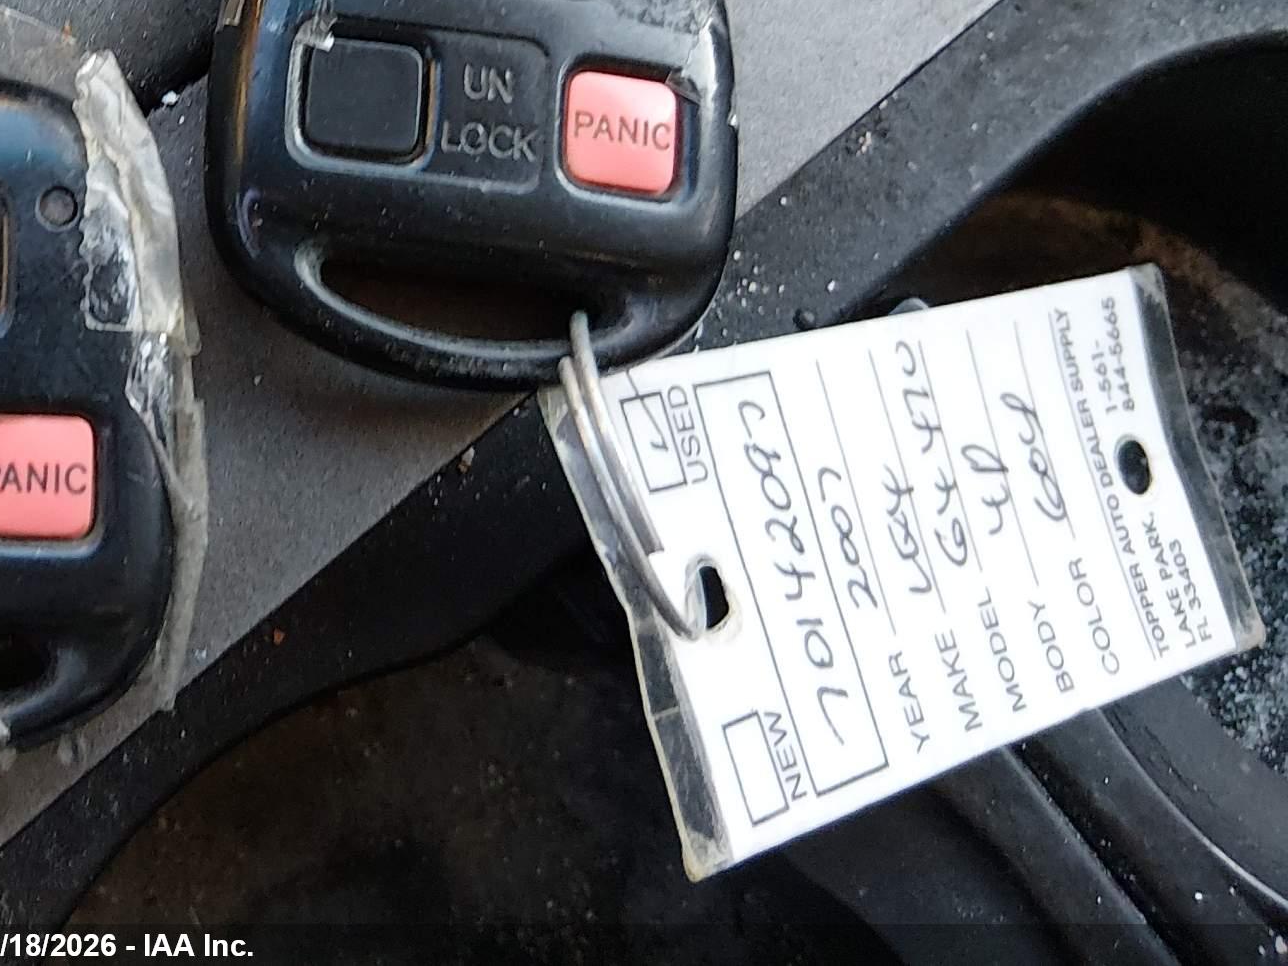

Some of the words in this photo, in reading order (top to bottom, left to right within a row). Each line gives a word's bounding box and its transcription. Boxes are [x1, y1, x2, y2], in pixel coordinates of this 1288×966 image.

[462, 62, 513, 104] UN
[439, 120, 538, 163] LOCK
[573, 110, 672, 151] PANIC
[1053, 307, 1084, 393] SUPPLY
[1102, 296, 1135, 412] 844-5665
[667, 385, 708, 484] USED
[1077, 398, 1114, 489] DEALER
[817, 466, 878, 609] 2007
[1106, 494, 1136, 555] AUTO
[1068, 557, 1120, 676] COLOR
[1129, 562, 1170, 658] TOPPER
[1165, 587, 1197, 649] LAKE
[1169, 538, 1202, 610] 33403
[977, 586, 1027, 712] MODEL
[1027, 600, 1075, 694] BODY
[1196, 616, 1213, 643] FL
[888, 650, 930, 754] YEAR
[935, 629, 983, 732] MAKE
[764, 711, 807, 802] NEW
